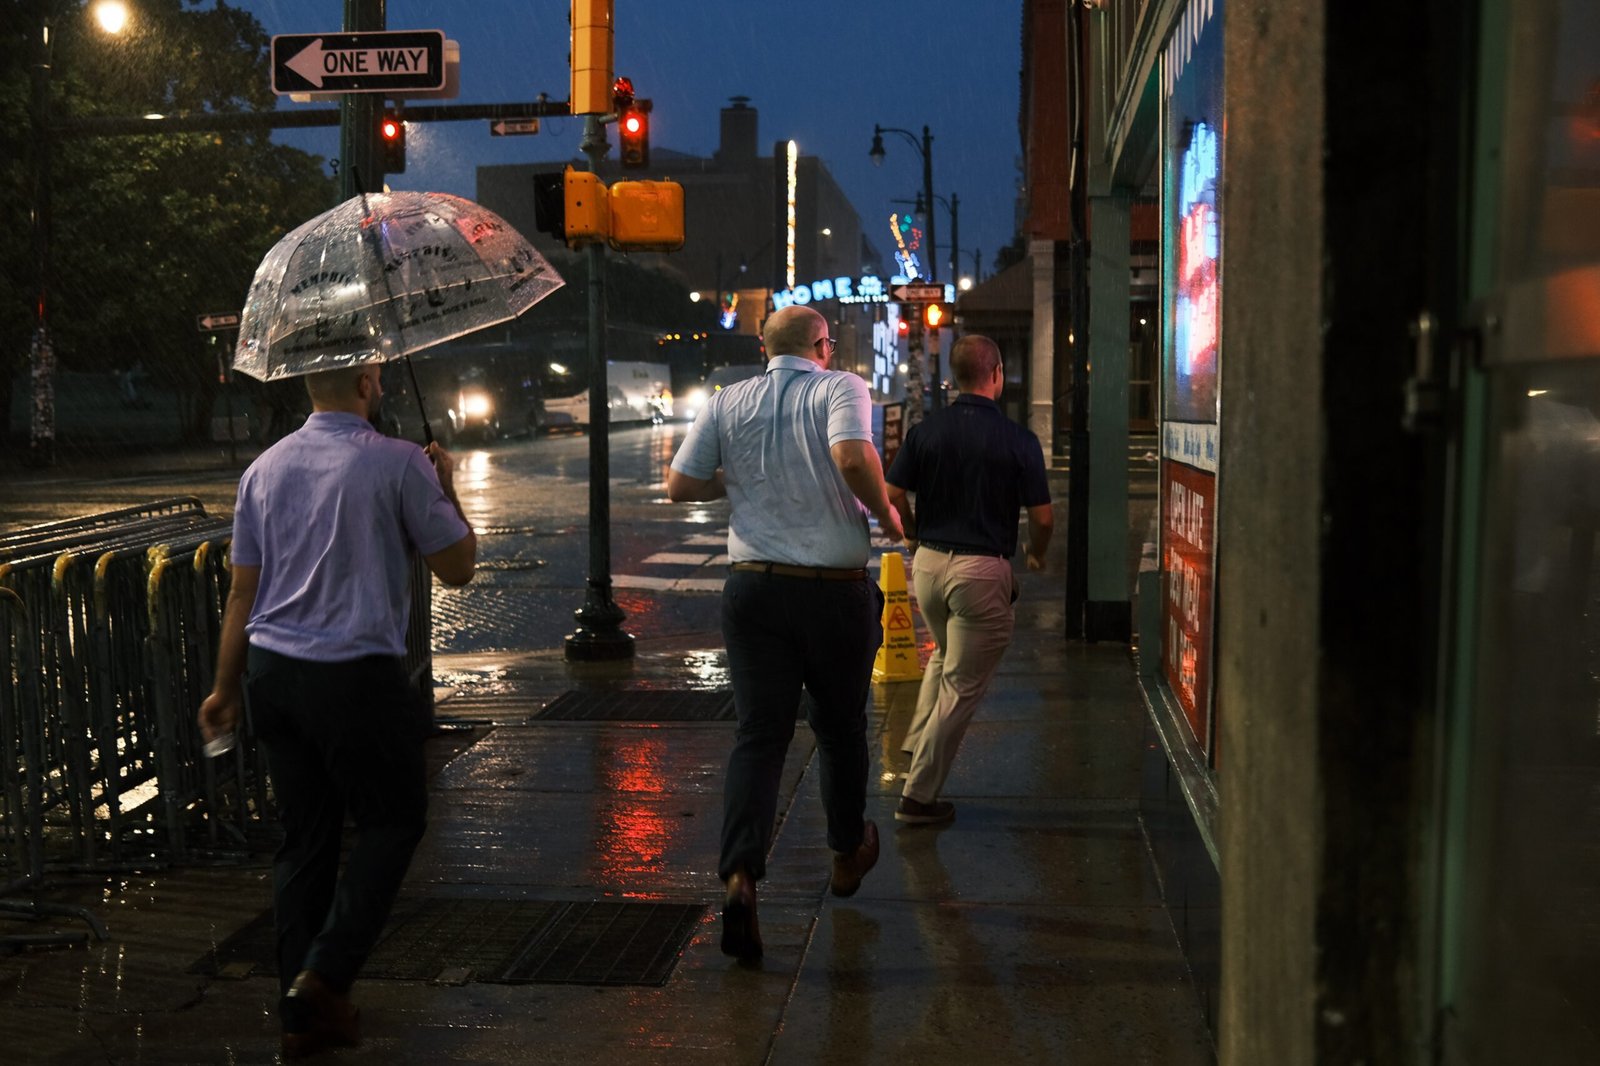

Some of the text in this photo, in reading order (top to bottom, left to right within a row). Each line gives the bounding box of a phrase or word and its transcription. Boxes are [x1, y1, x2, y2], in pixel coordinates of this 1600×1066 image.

[323, 49, 424, 74] ONE WAY
[772, 276, 852, 311] HOME
